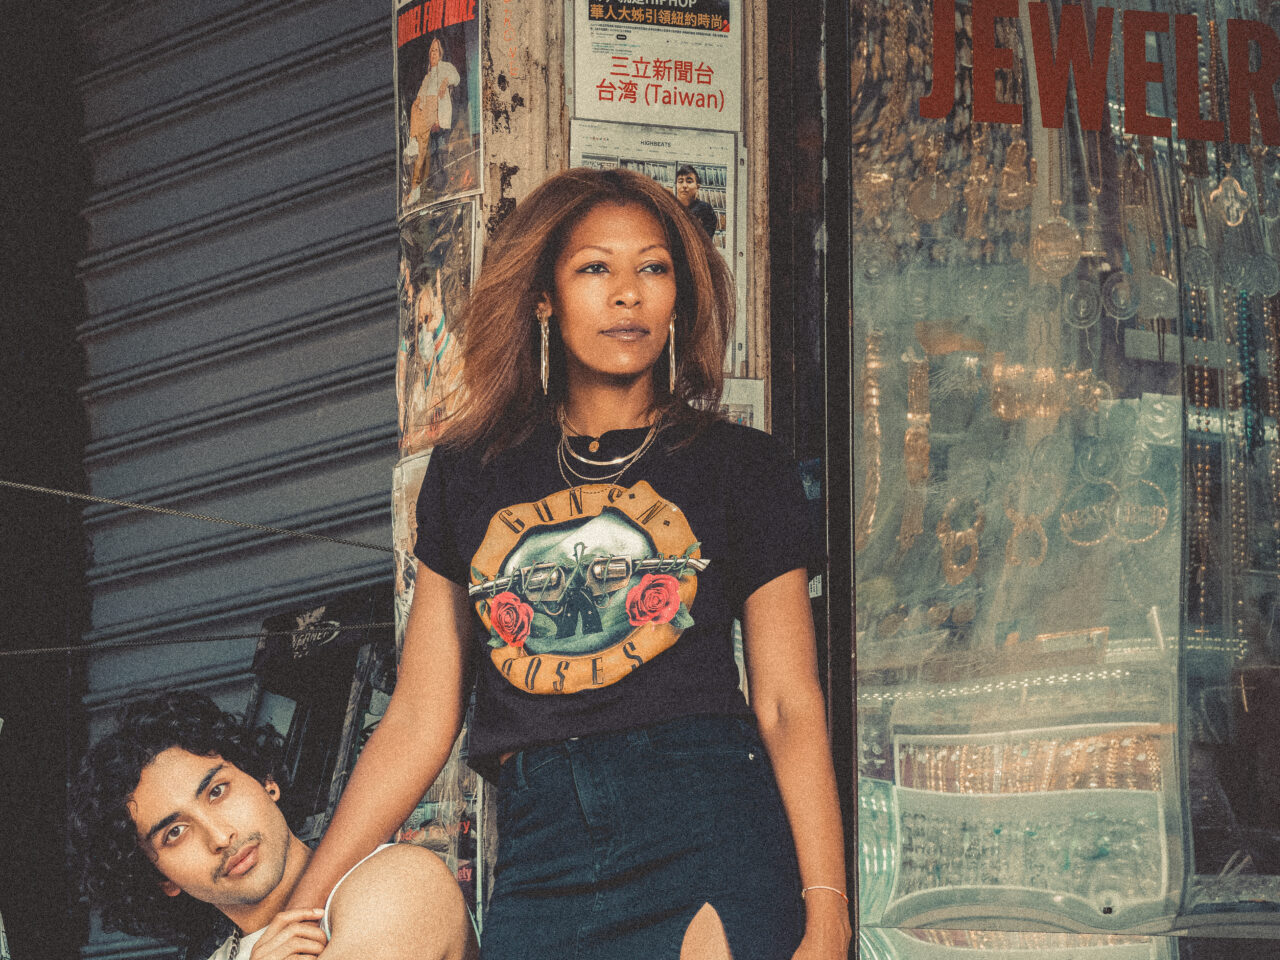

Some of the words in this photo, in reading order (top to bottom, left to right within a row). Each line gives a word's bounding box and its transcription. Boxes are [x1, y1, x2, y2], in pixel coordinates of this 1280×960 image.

[610, 56, 715, 85] 三立新聞台
[644, 83, 725, 112] (Taiwan)
[640, 140, 672, 148] HIGHBEATS
